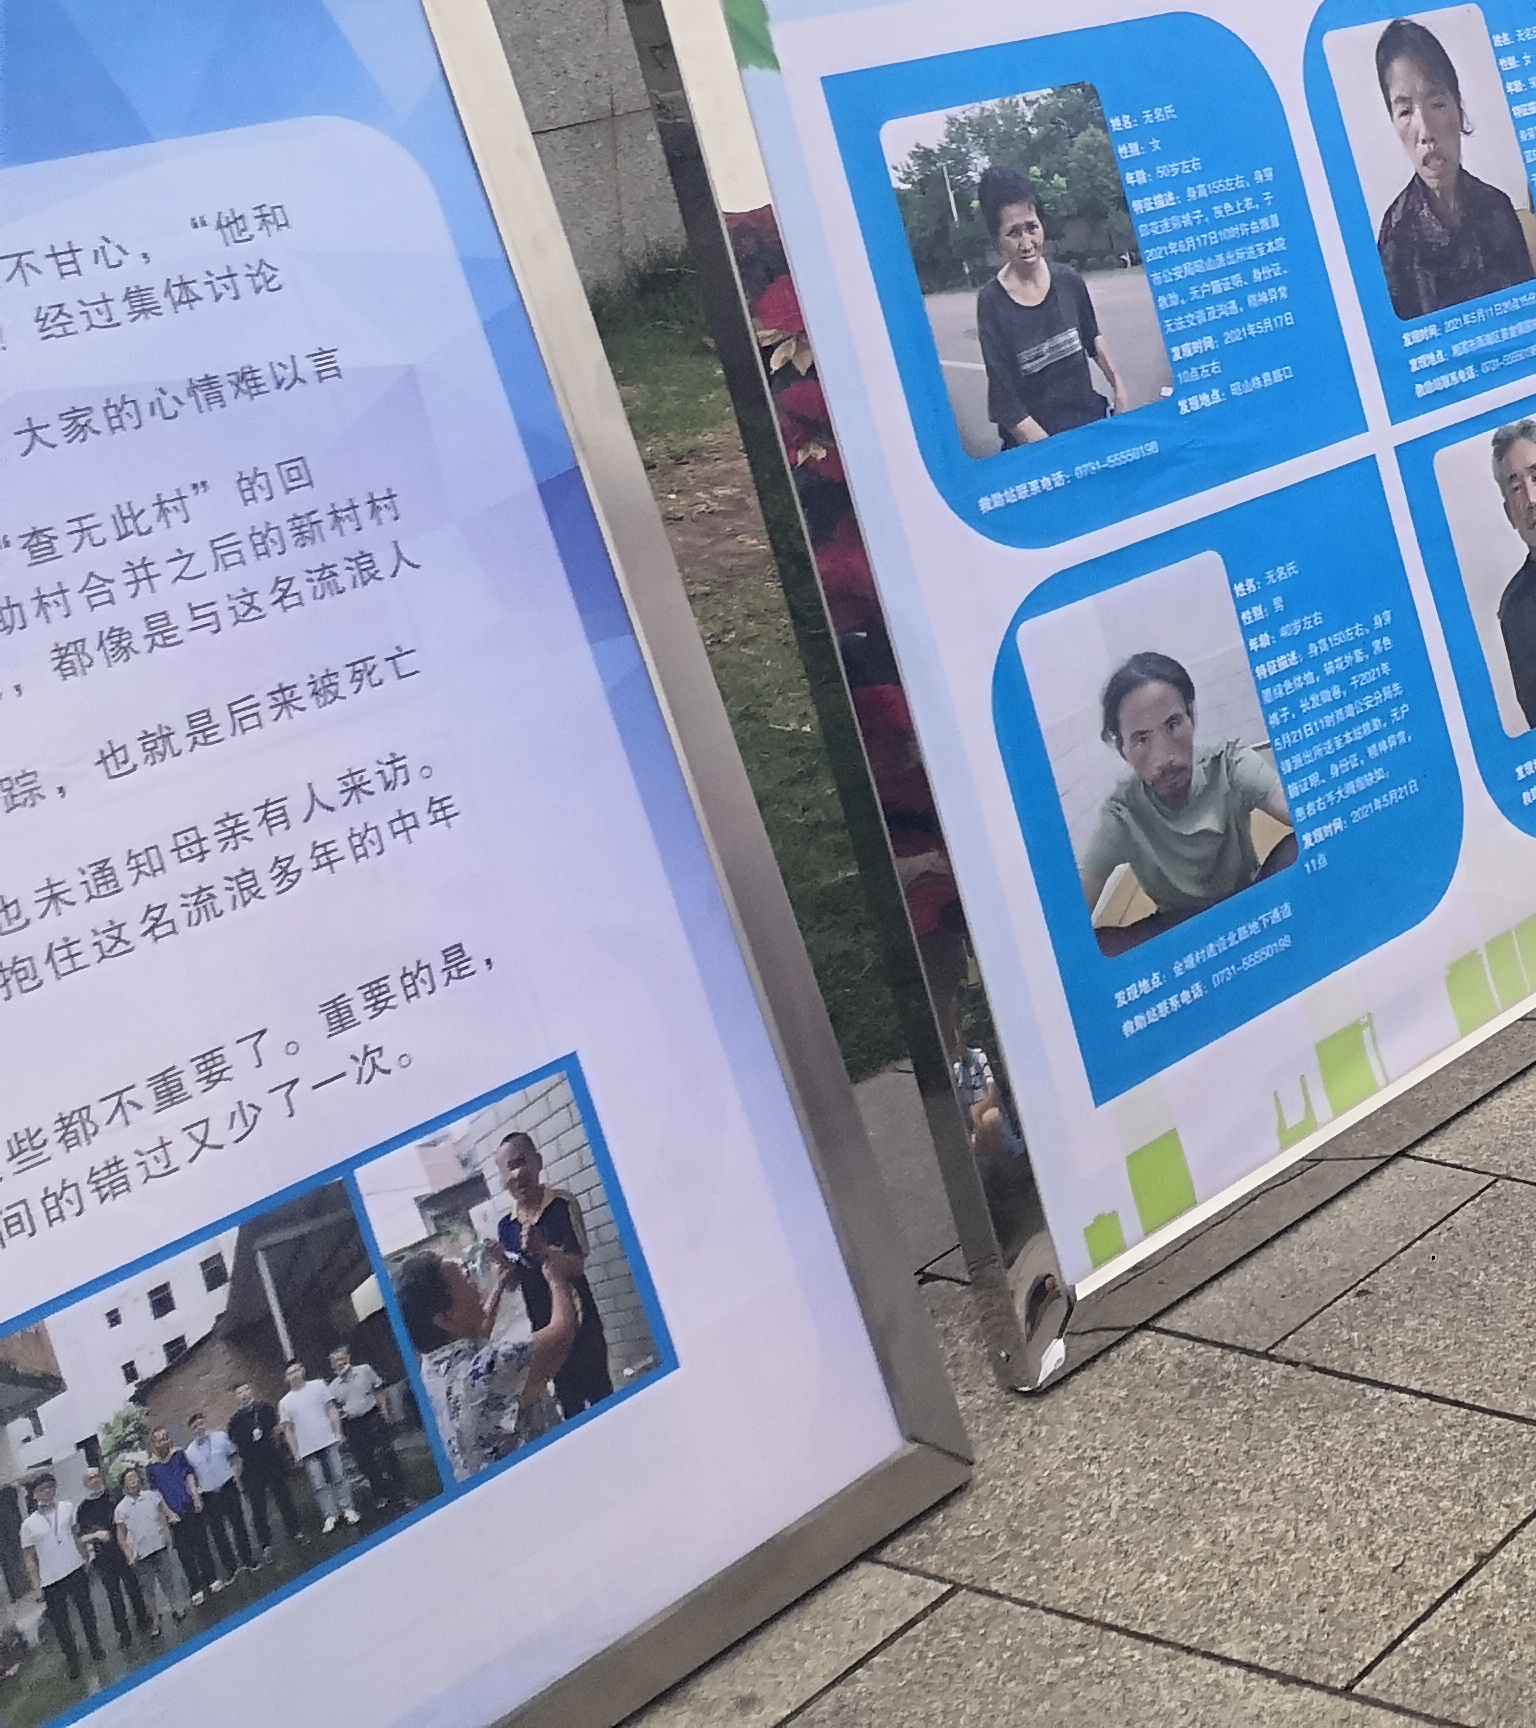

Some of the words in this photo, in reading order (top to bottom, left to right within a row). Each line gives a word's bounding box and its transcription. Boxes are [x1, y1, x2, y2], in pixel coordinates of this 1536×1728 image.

[13, 347, 344, 457] 大家的心情难以言
